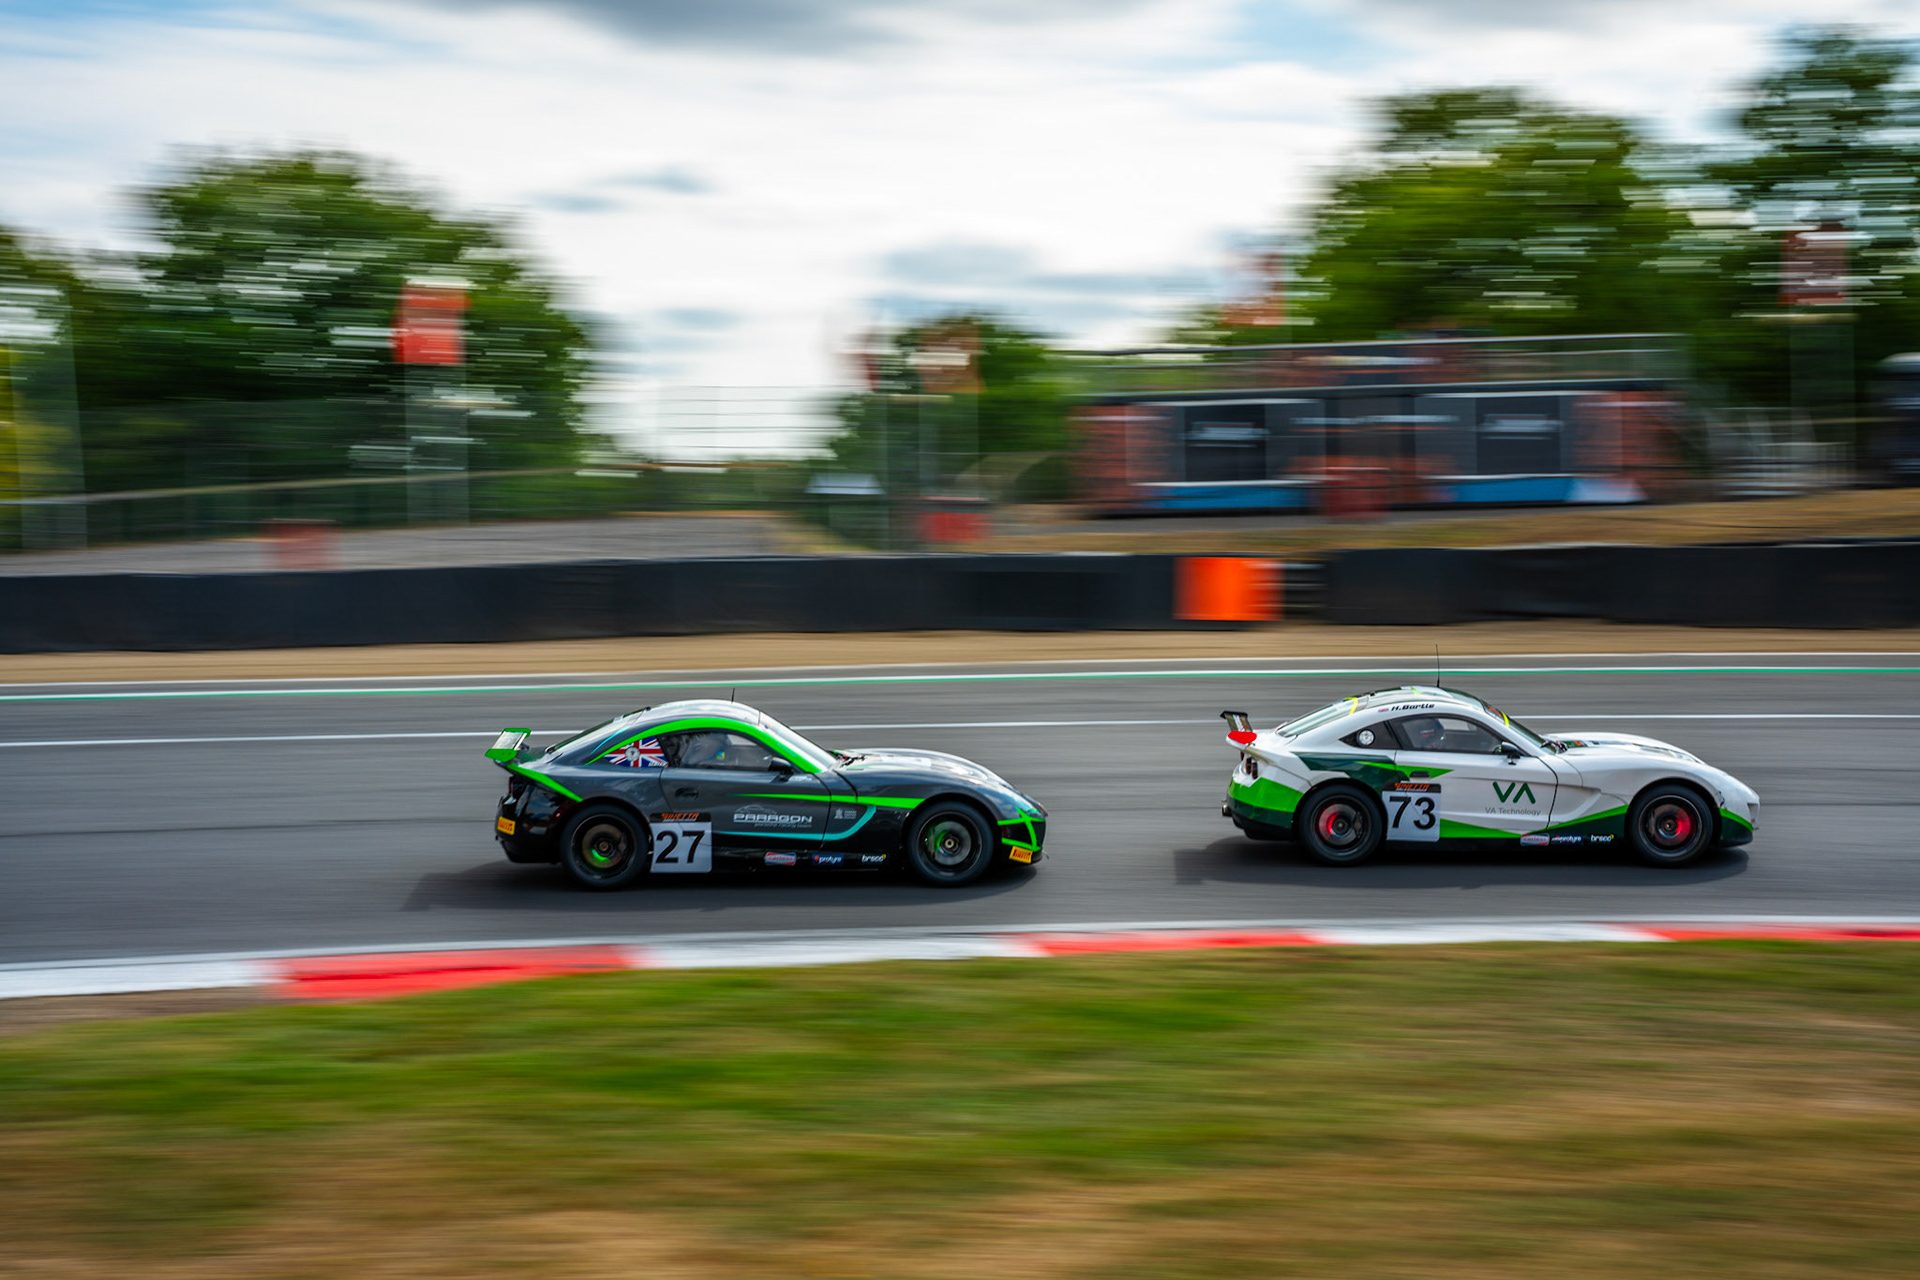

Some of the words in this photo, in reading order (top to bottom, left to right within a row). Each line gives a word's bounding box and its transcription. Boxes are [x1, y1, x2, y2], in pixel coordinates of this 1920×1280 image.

[1492, 781, 1536, 804] VA
[733, 813, 813, 824] PARAGON
[1389, 796, 1436, 831] 73
[1499, 807, 1541, 817] Technology
[655, 830, 705, 864] 27
[818, 855, 842, 864] protyre
